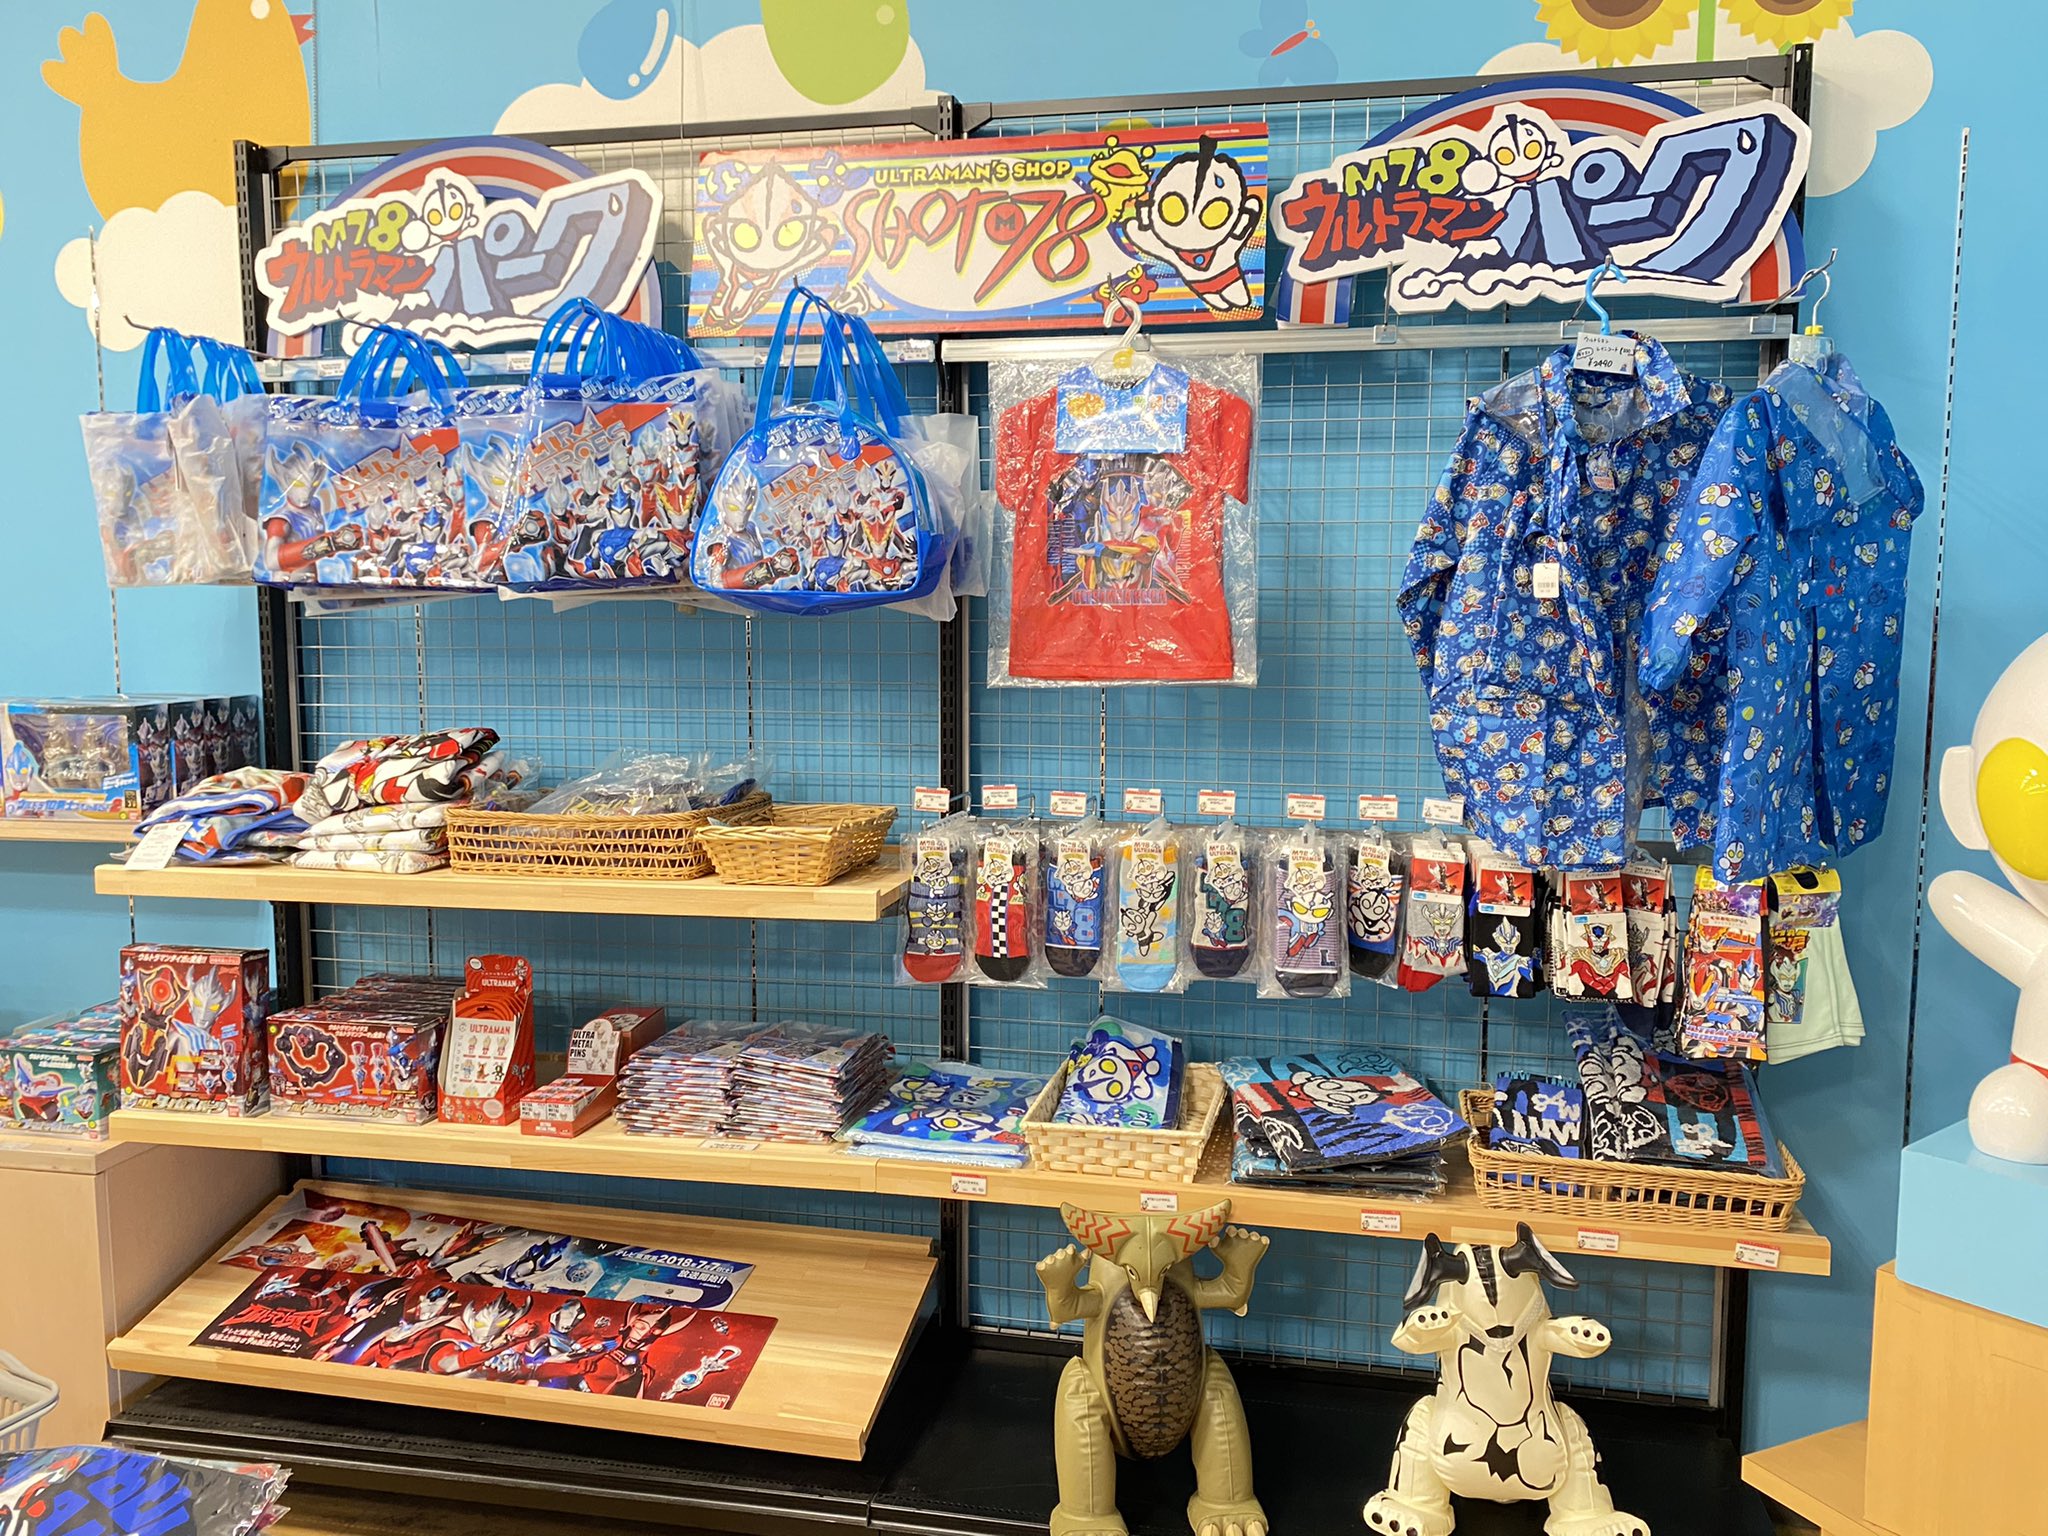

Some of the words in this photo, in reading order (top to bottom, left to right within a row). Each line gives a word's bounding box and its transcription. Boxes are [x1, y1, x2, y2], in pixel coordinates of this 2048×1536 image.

[874, 160, 1010, 187] ULTRAMAN'S
[1012, 160, 1073, 181] SHOP
[1343, 138, 1469, 197] M78
[1490, 114, 1785, 275] パーク
[312, 201, 411, 255] M78
[1284, 178, 1508, 263] ウルトラマン
[428, 178, 644, 318] パーク
[267, 236, 437, 314] ウルトラマン
[481, 978, 517, 987] ULTRAMAN
[470, 1023, 511, 1035] ULTRAMAN
[571, 1040, 593, 1049] METAL
[573, 1031, 596, 1040] ULTRA
[569, 1049, 587, 1058] PINS
